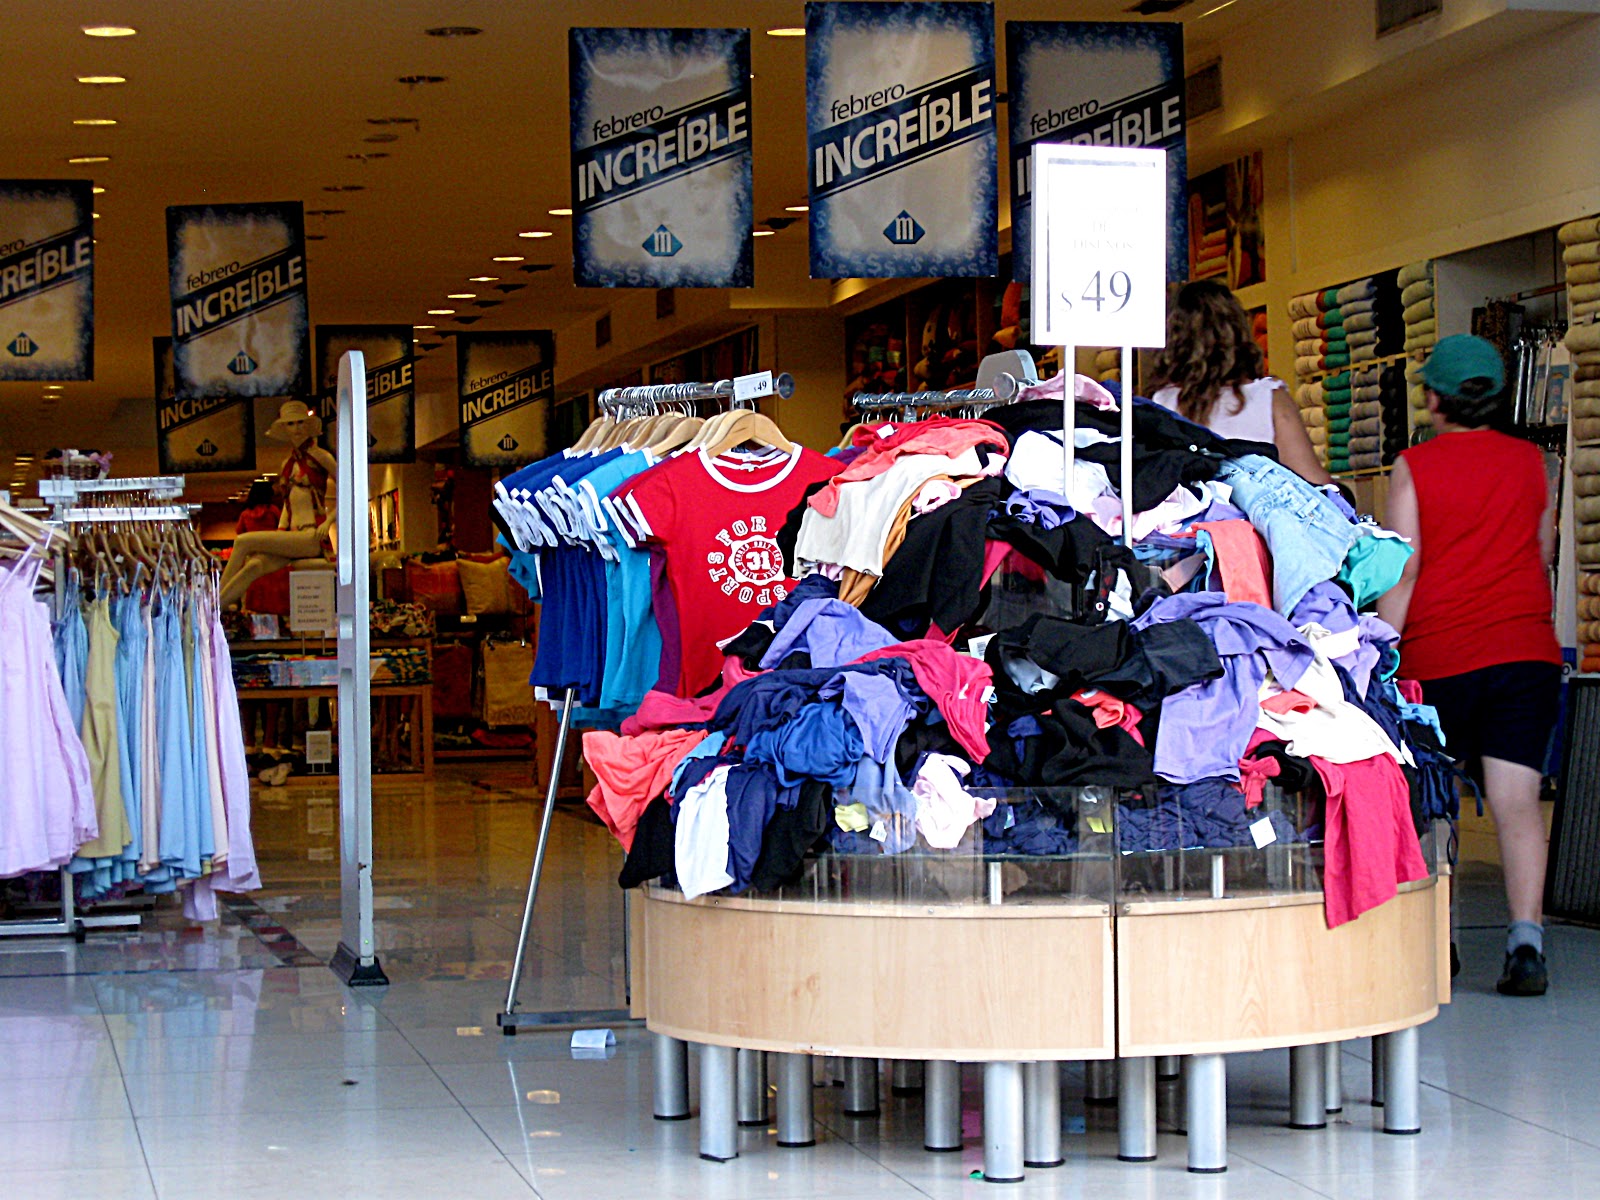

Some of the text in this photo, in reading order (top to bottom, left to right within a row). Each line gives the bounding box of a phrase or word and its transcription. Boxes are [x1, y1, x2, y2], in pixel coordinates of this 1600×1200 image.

[831, 83, 905, 122] febrero
[1030, 99, 1099, 136] febrero
[593, 106, 663, 141] febrero
[815, 79, 992, 188] INCREÍBLE
[578, 101, 747, 202] INCREÍBLE
[0, 236, 90, 298] REÍBLE
[187, 261, 241, 290] febrero
[176, 256, 304, 337] INCREÍBLE
[1081, 270, 1132, 313] 49
[321, 363, 412, 419] INEÍBLE
[462, 369, 551, 424] INCREÍBLE
[469, 370, 509, 391] febrero
[757, 381, 767, 391] 49
[715, 516, 767, 547] FOR
[708, 552, 788, 605] SPORTS
[745, 551, 771, 570] 31
